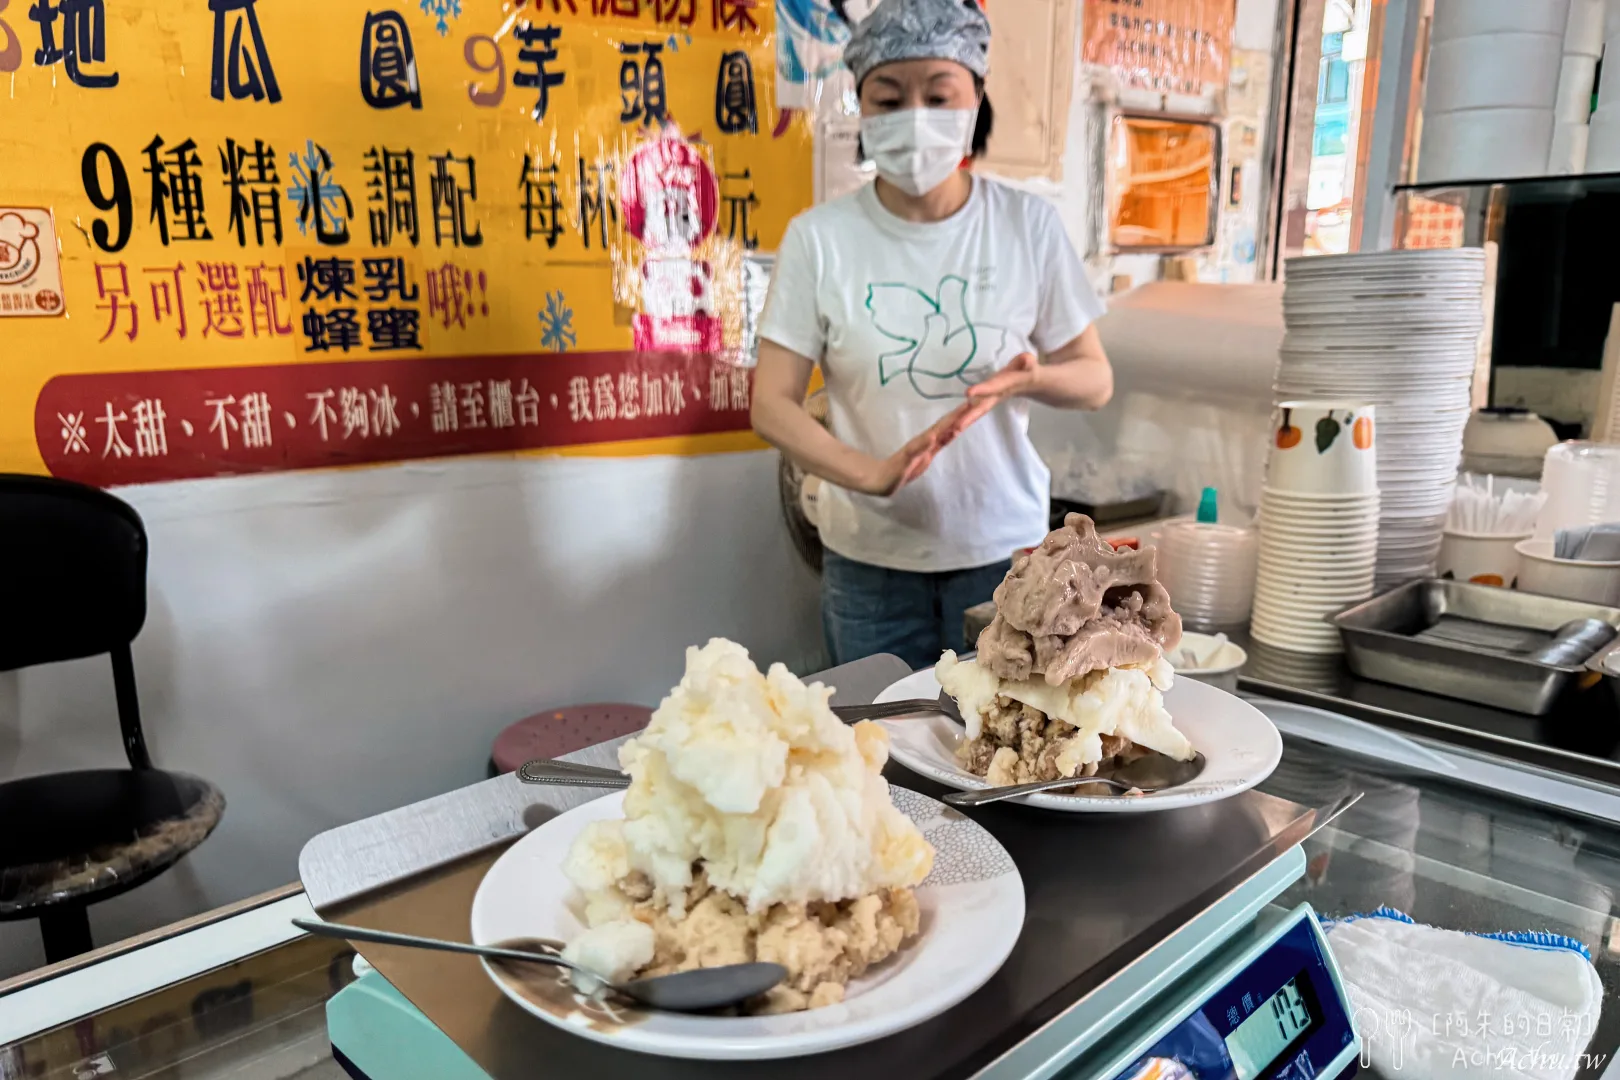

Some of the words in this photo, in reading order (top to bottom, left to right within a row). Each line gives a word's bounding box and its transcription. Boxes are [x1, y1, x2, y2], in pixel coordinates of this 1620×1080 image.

[81, 134, 483, 253] 9種精心調配
[94, 259, 293, 342] 另可選配
[299, 255, 419, 303] 煉乳
[302, 307, 423, 353] 蜂蜜
